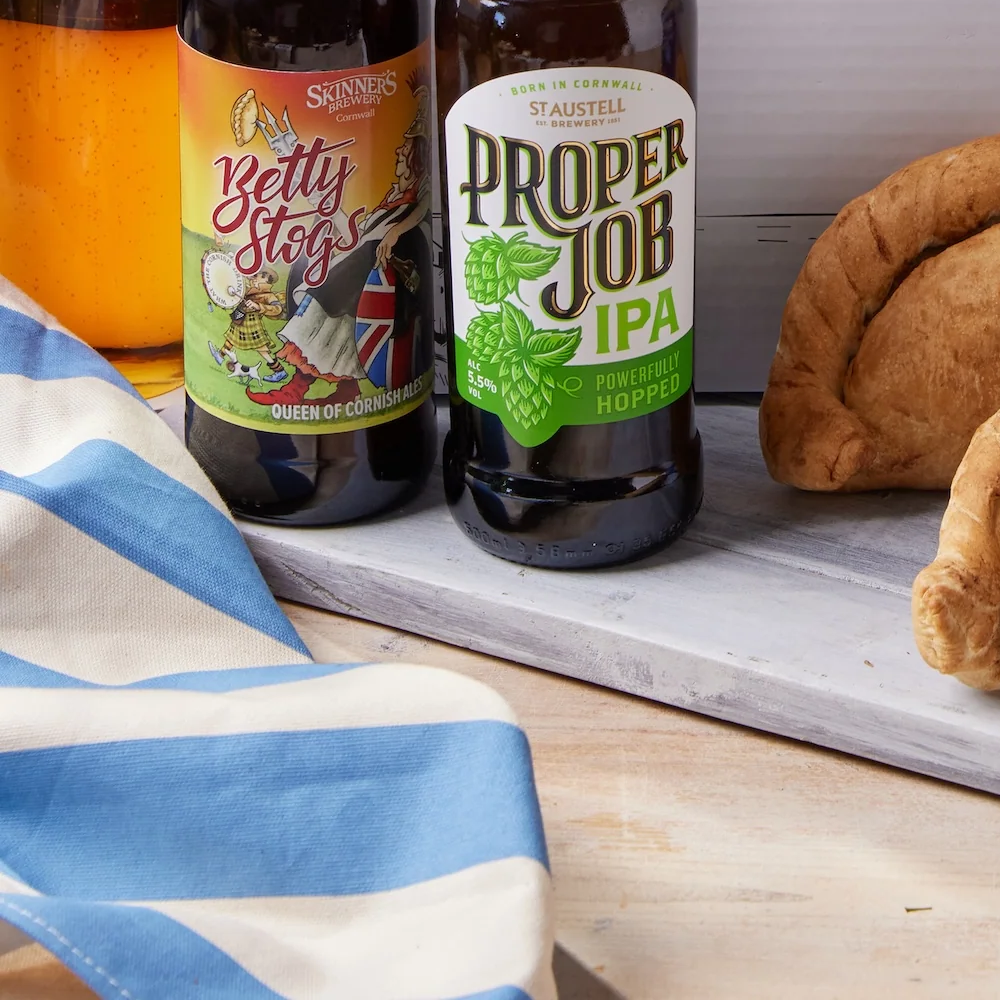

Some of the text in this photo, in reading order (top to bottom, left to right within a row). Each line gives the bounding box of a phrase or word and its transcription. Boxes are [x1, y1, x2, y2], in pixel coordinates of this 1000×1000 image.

[511, 79, 643, 96] BORN IN CORNWALL
[328, 94, 382, 114] BREWERY
[336, 108, 375, 123] Cornwall
[549, 98, 626, 117] AUSTELL
[551, 118, 605, 128] BREWERY
[212, 136, 356, 234] Betty
[460, 118, 688, 239] PROPER
[235, 205, 365, 287] Stogs
[539, 189, 673, 322] JOB
[595, 286, 680, 355] IPA
[468, 358, 481, 372] ALC
[596, 351, 680, 391] POWERFULLY
[468, 369, 497, 394] 5.5%
[468, 385, 482, 400] VOL
[597, 373, 680, 415] HOPPED
[271, 404, 320, 421] QUEEN
[323, 404, 342, 420] OF
[403, 376, 423, 401] ALES
